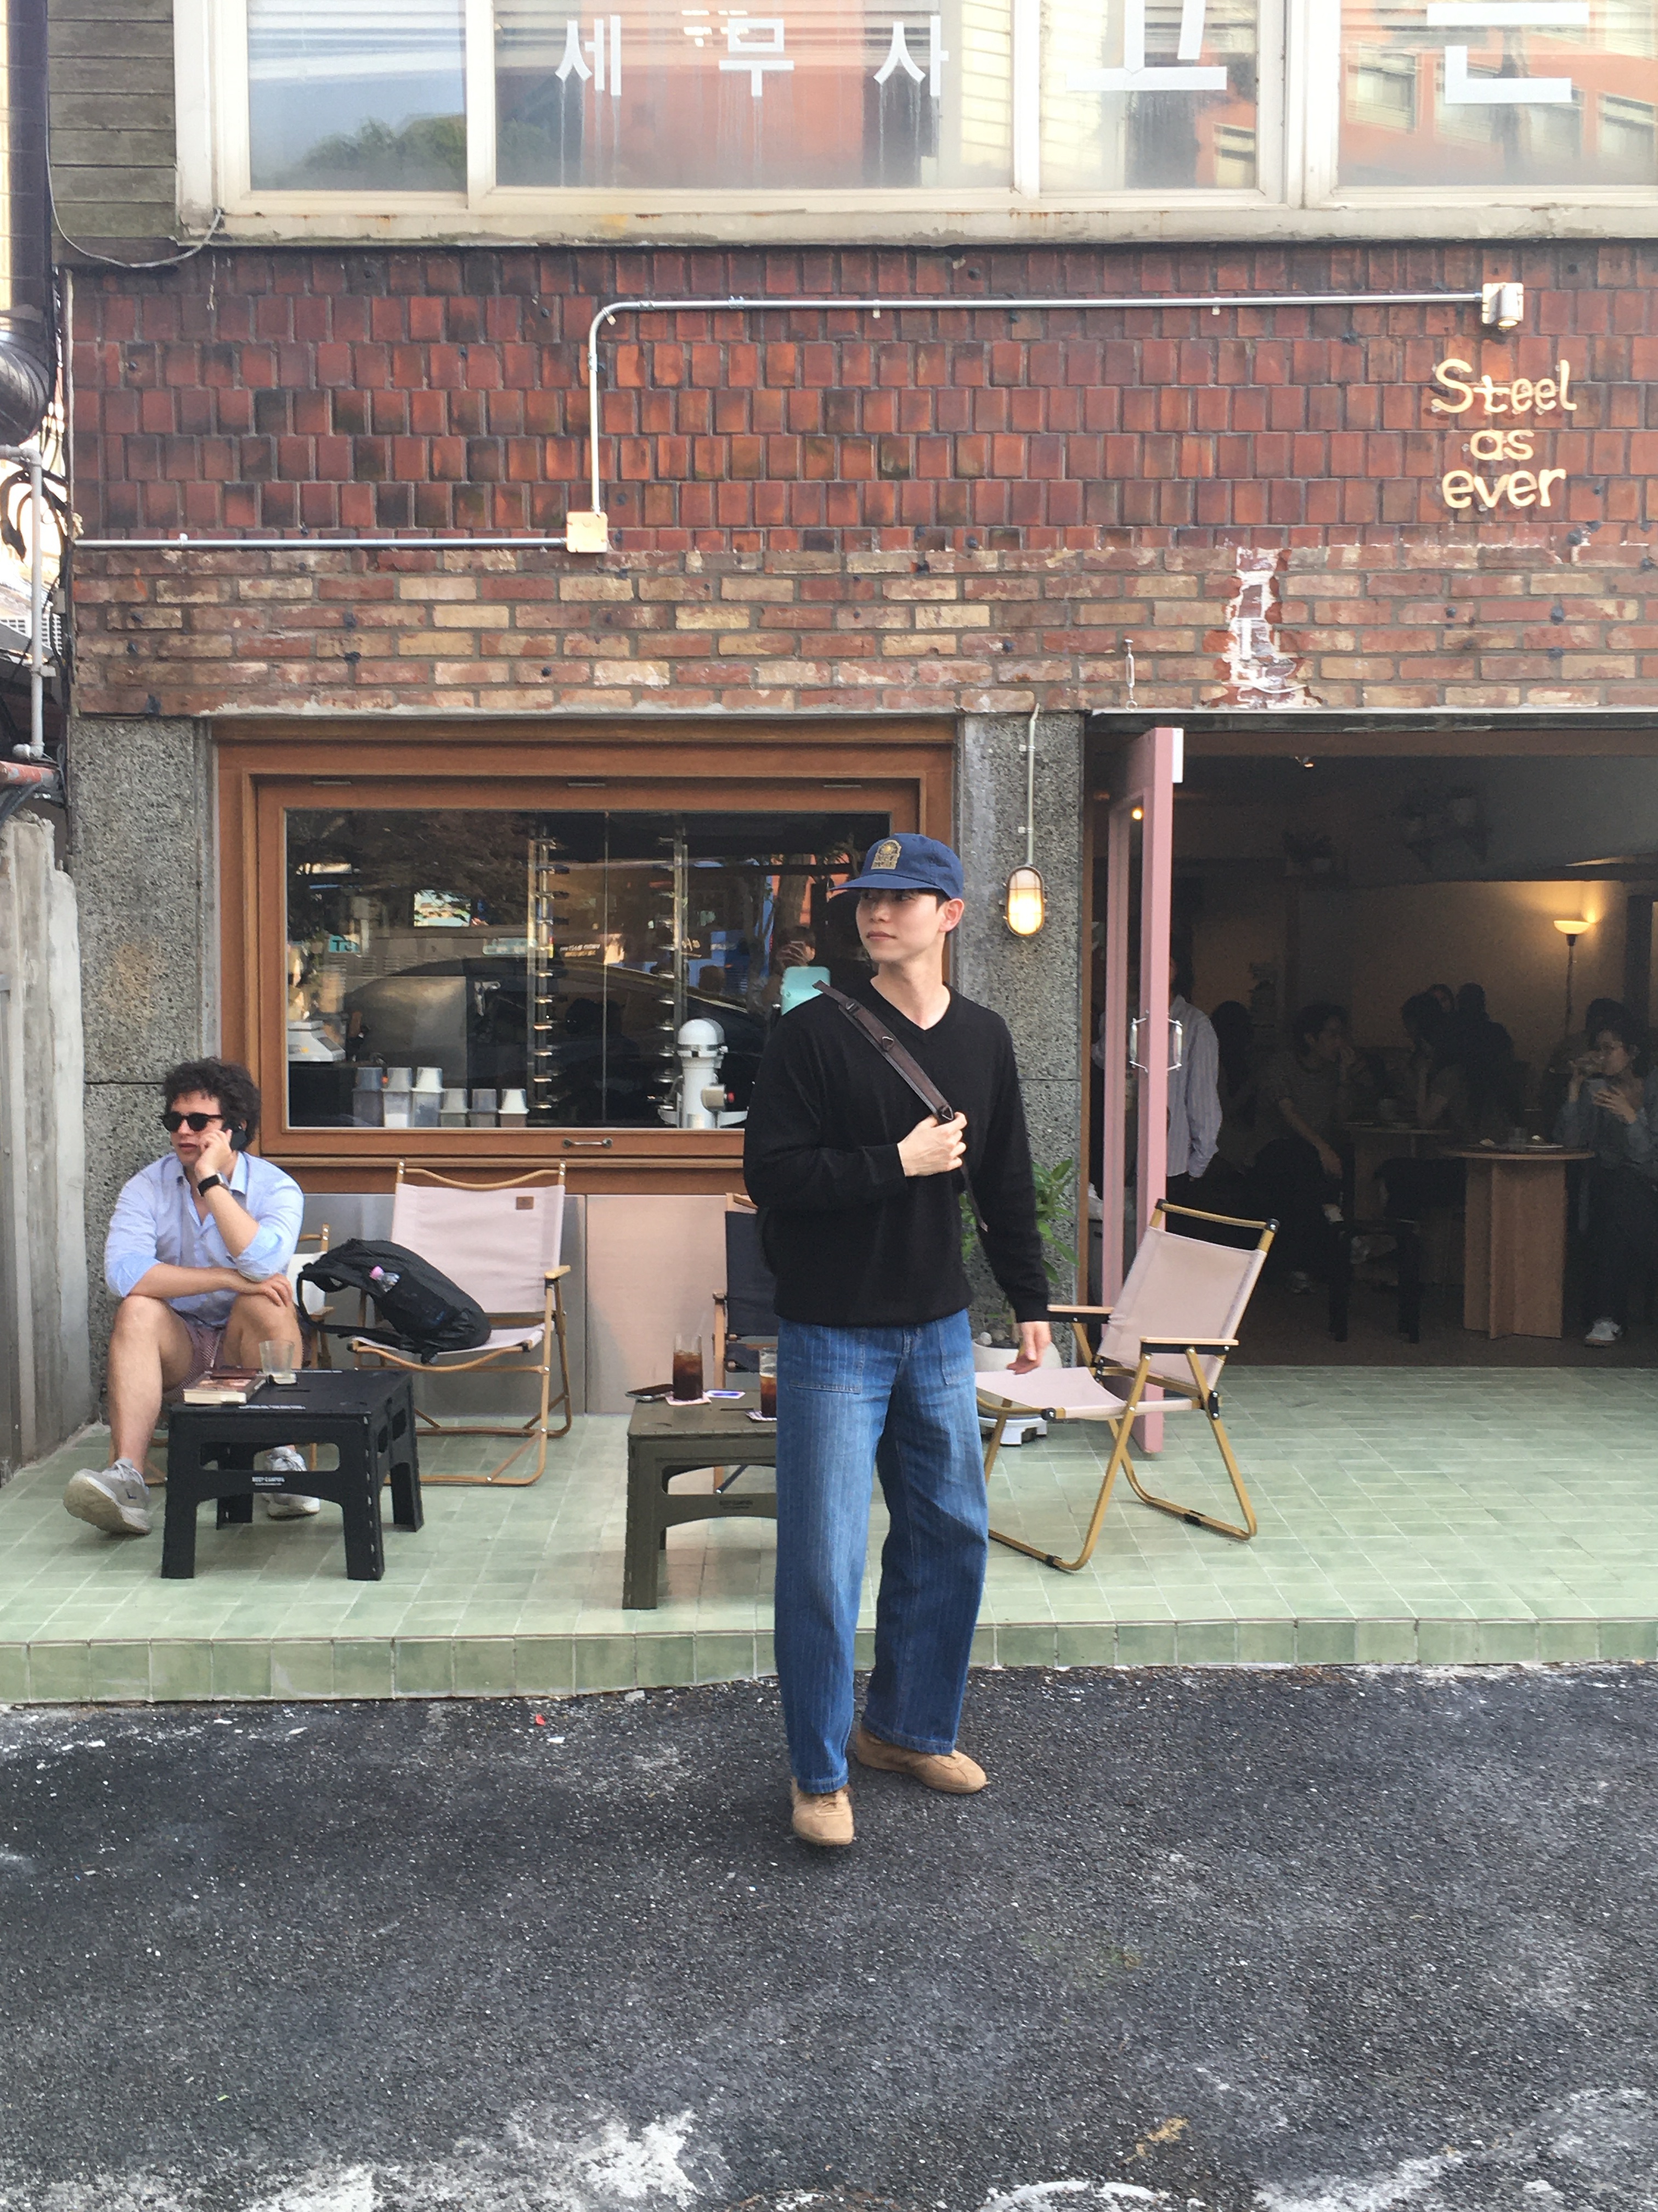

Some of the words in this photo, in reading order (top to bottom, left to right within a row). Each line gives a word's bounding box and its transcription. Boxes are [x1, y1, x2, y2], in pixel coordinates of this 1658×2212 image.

[555, 15, 949, 97] 세무사
[1431, 358, 1577, 413] Steel
[1470, 430, 1535, 461] as
[1441, 469, 1567, 509] ever
